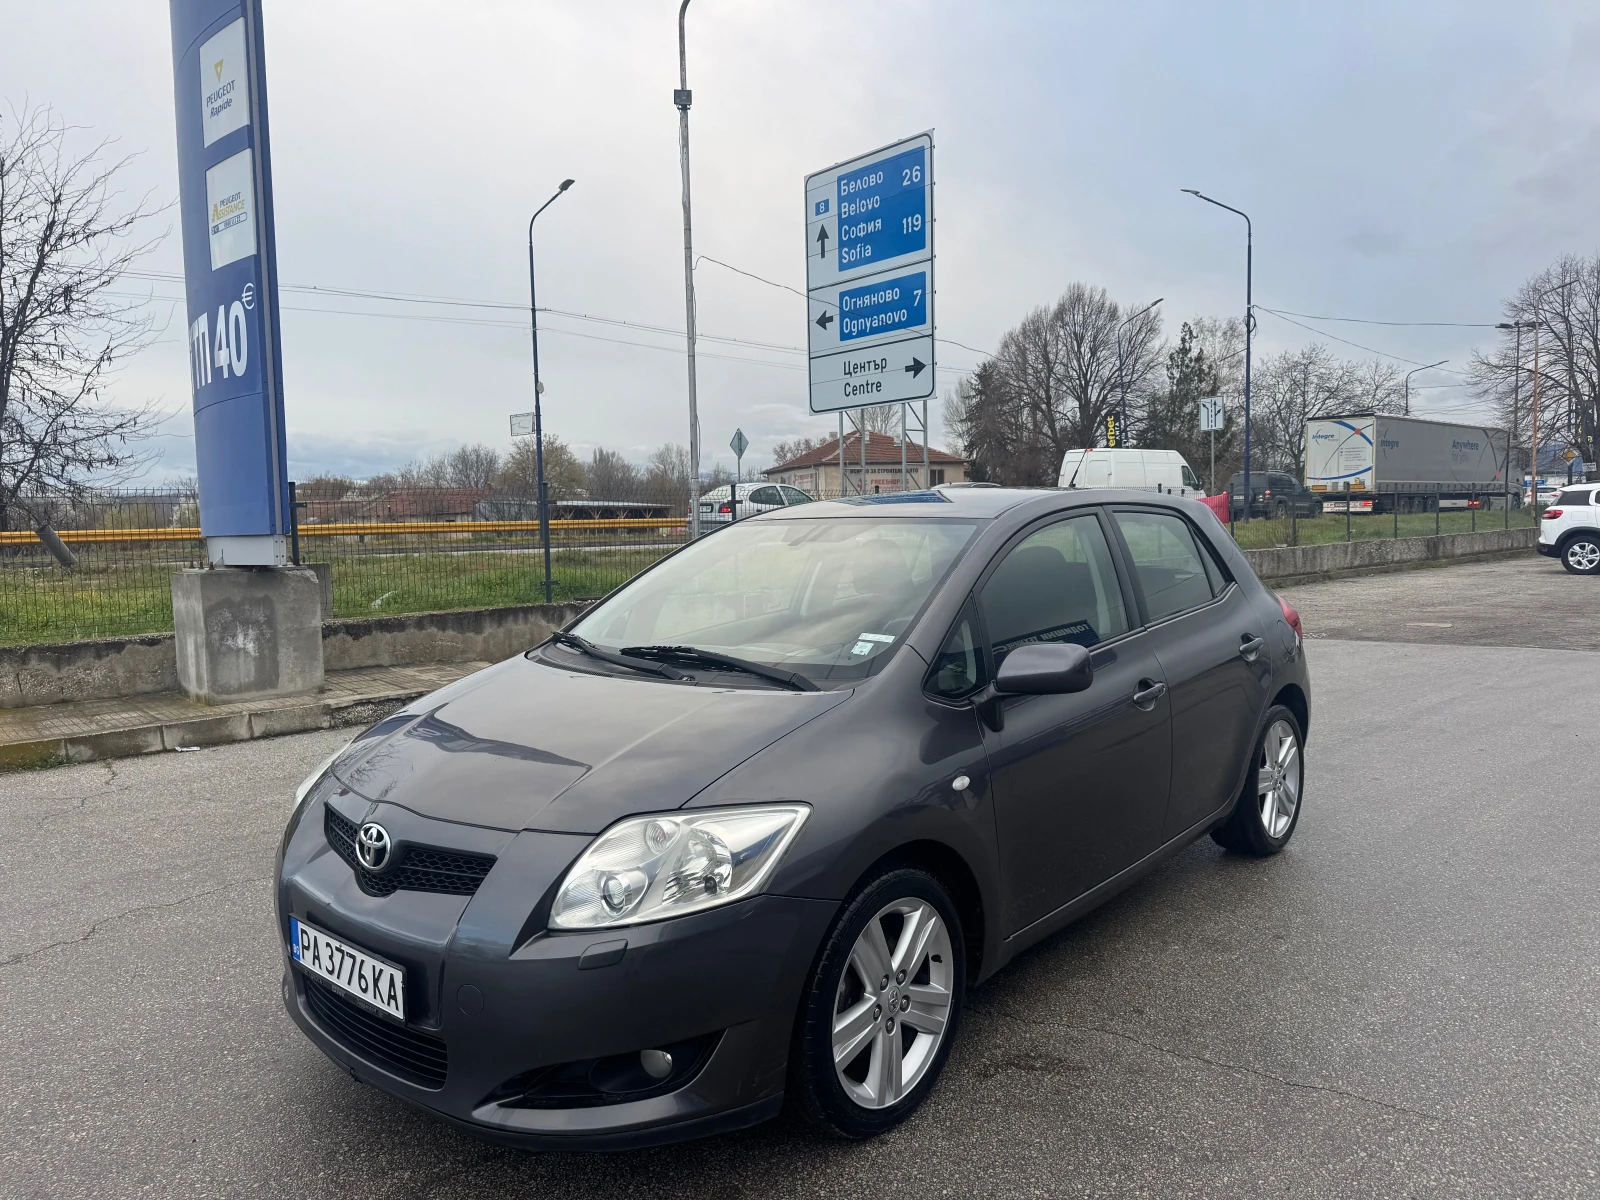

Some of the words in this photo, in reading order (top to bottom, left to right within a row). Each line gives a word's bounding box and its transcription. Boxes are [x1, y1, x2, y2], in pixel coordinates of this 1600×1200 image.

[206, 80, 235, 107] PEUGEOT
[210, 98, 233, 118] Rapide
[841, 171, 884, 196] Белово
[902, 165, 921, 186] 26
[220, 192, 241, 208] PEUGEOT
[819, 202, 825, 213] 8
[841, 195, 881, 218] Belovo
[841, 218, 882, 241] София
[902, 214, 922, 235] 119
[841, 243, 872, 263] Sofia
[842, 287, 900, 311] Огняново
[913, 289, 922, 307] 7
[843, 309, 908, 335] Ognyanovo
[843, 357, 887, 377] Център
[844, 380, 882, 397] Centre
[1107, 415, 1115, 447] efbet
[1312, 433, 1335, 441] Integre
[1381, 438, 1399, 449] Integre
[1452, 439, 1479, 452] Anywhere
